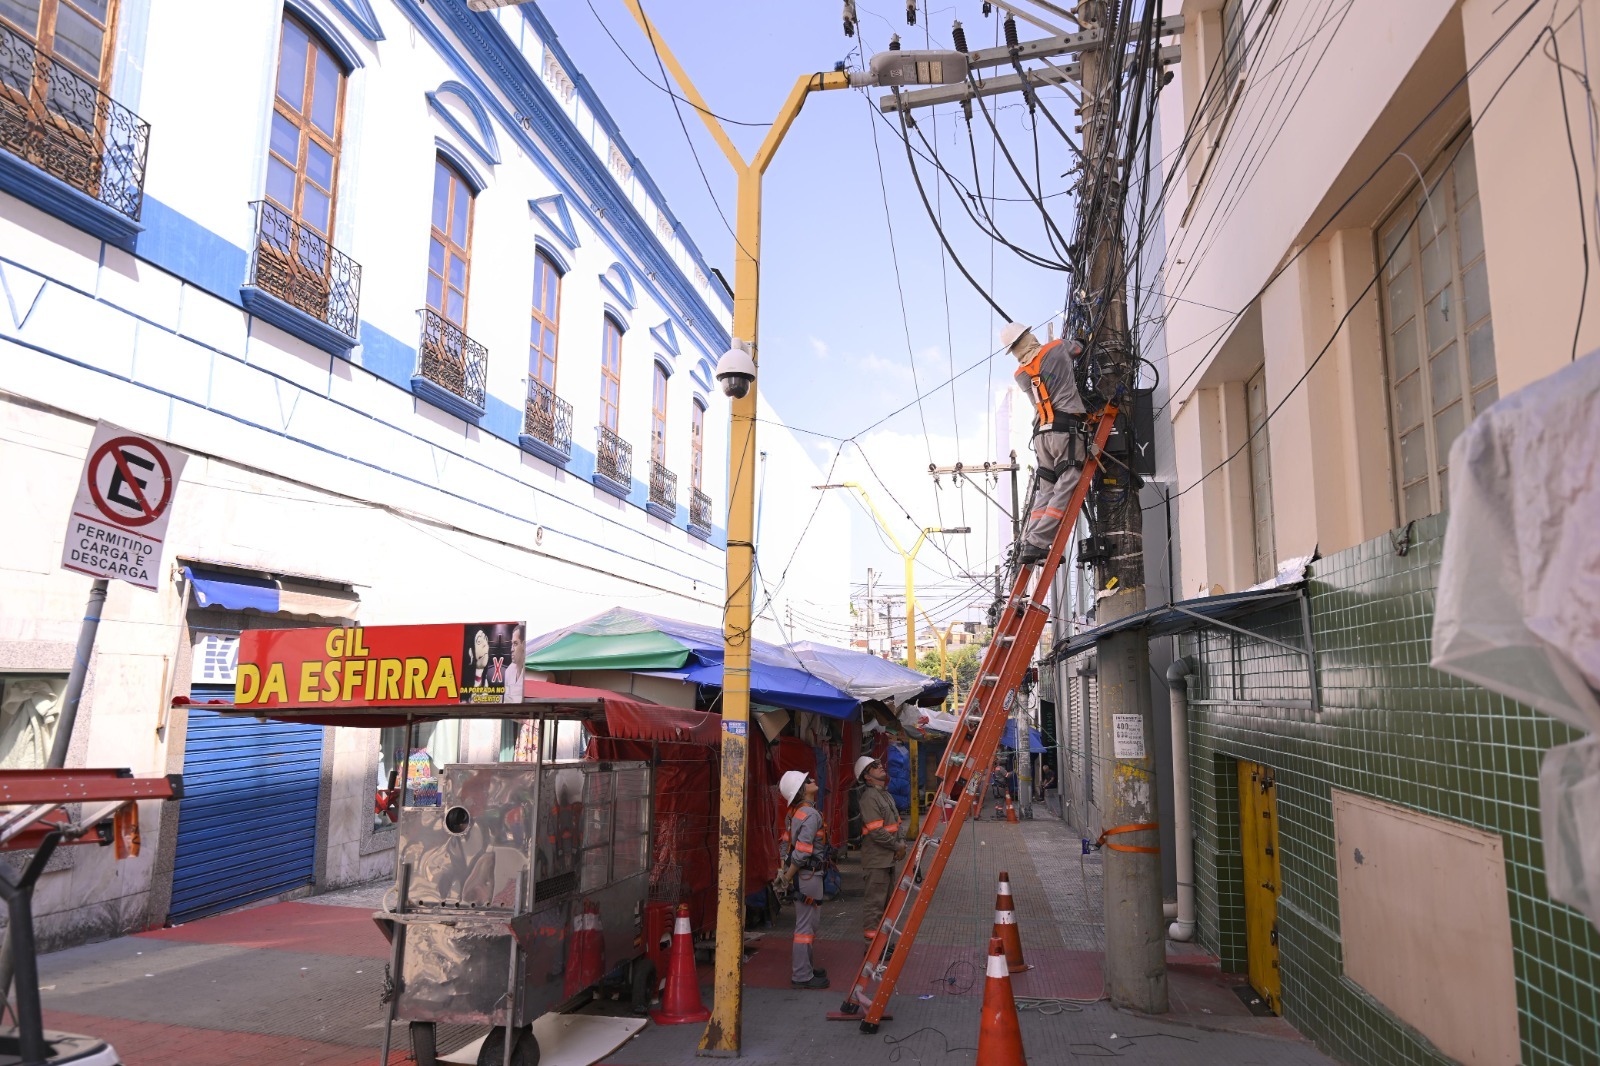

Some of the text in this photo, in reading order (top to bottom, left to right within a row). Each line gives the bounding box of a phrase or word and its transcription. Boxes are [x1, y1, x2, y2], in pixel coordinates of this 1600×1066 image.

[76, 522, 153, 555] PERMITIDO
[80, 538, 145, 566] CARGA E
[70, 549, 149, 581] DESCARGA
[325, 627, 370, 658] GIL
[234, 656, 459, 705] DA ESFIRRA
[491, 656, 505, 683] X
